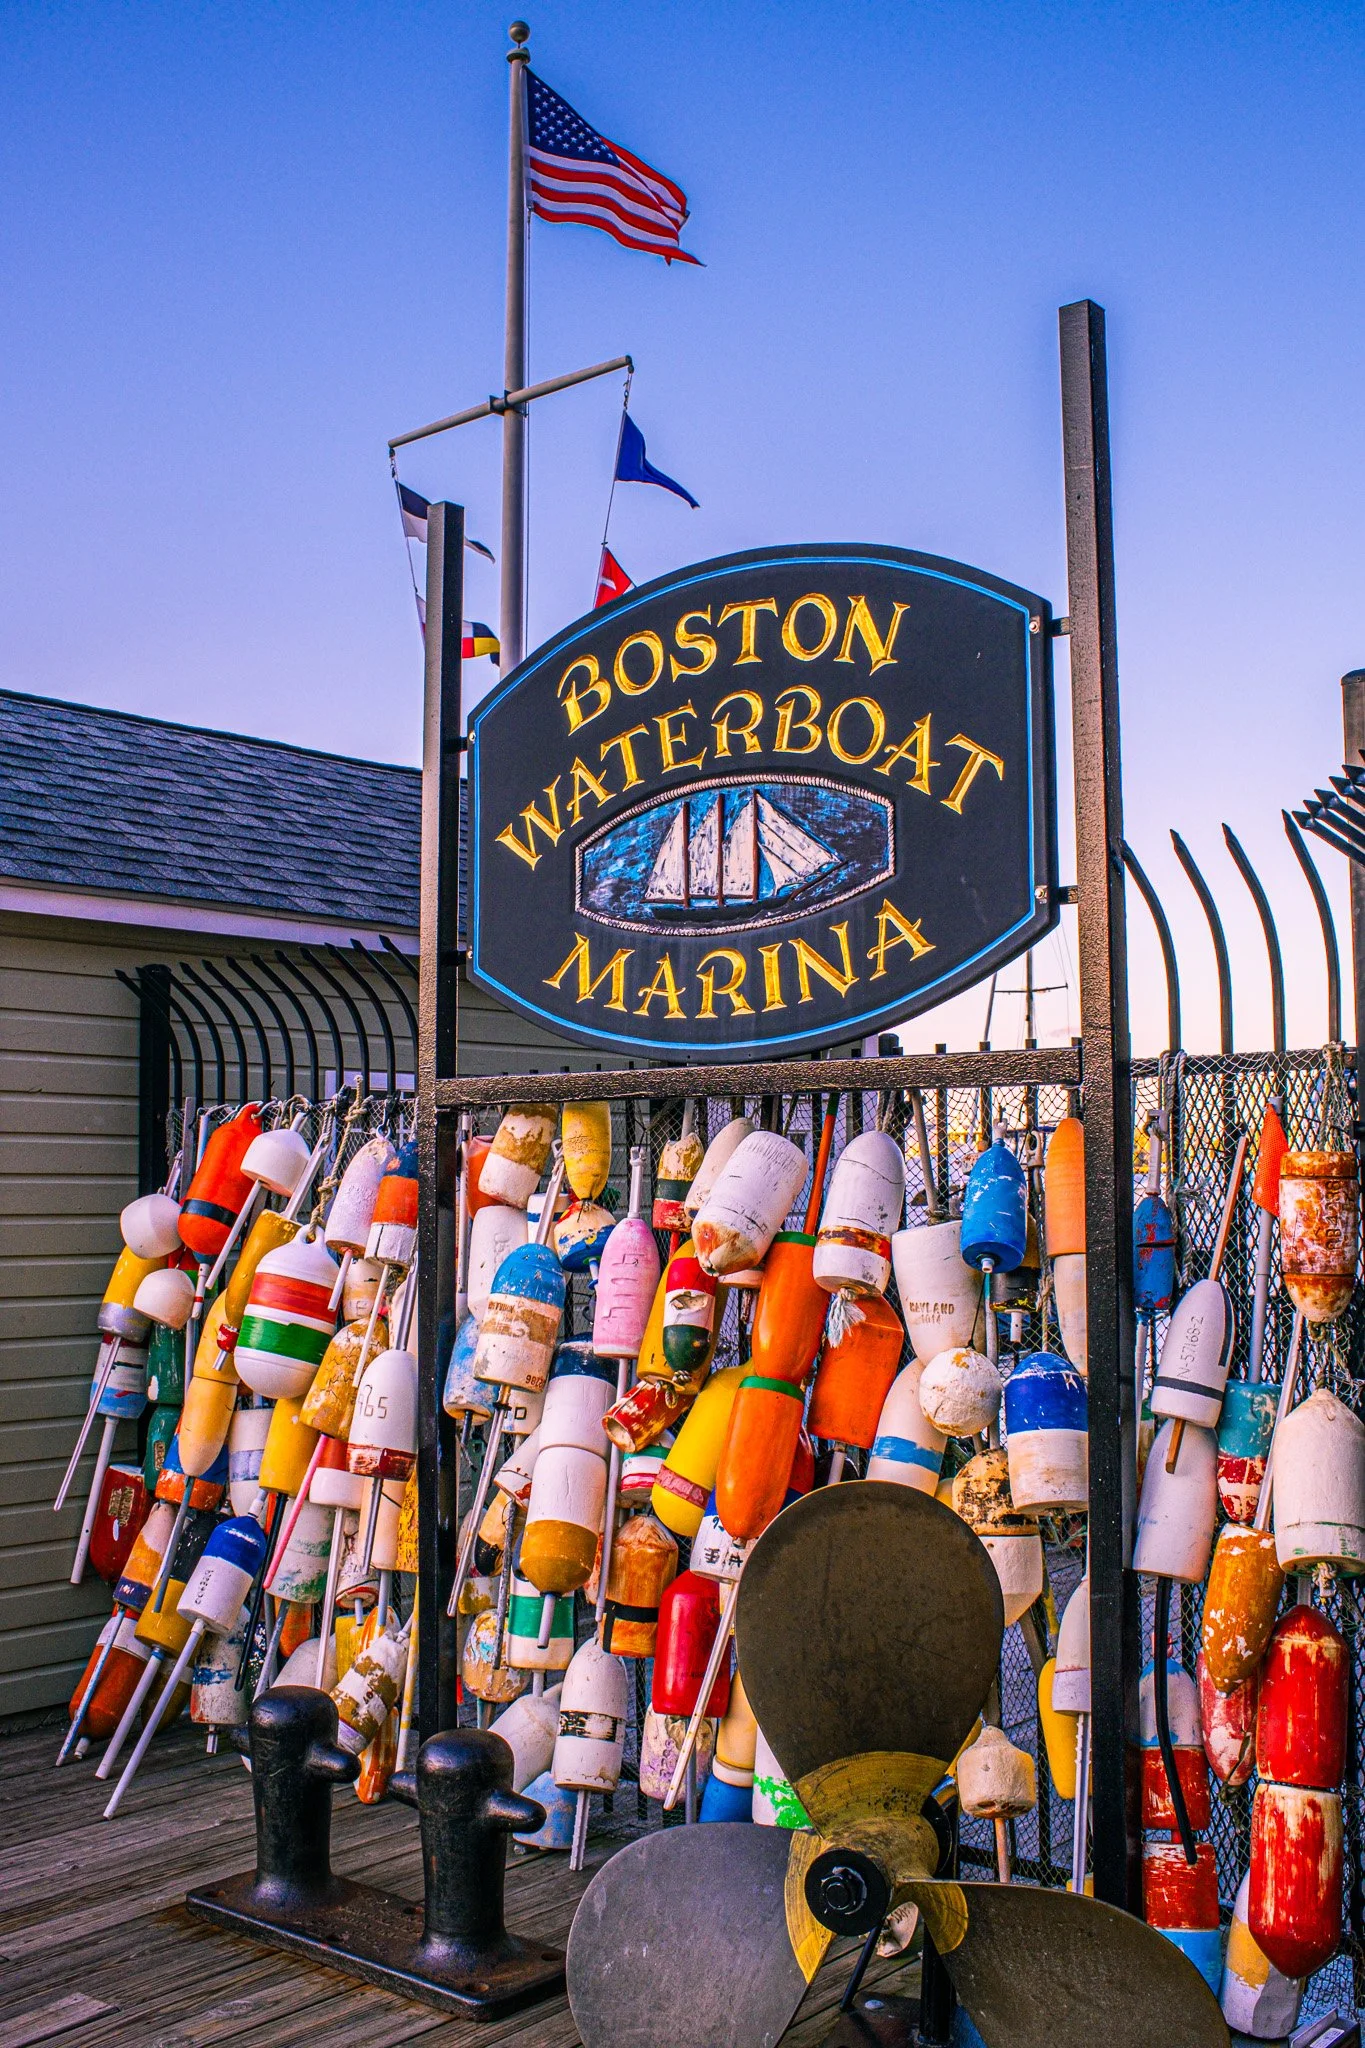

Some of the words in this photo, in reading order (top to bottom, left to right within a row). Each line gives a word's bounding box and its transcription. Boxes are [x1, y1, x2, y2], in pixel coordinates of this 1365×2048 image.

[557, 592, 911, 736] BOSTON
[495, 684, 1004, 871] WATERBOAT
[543, 898, 936, 1019] MARINA
